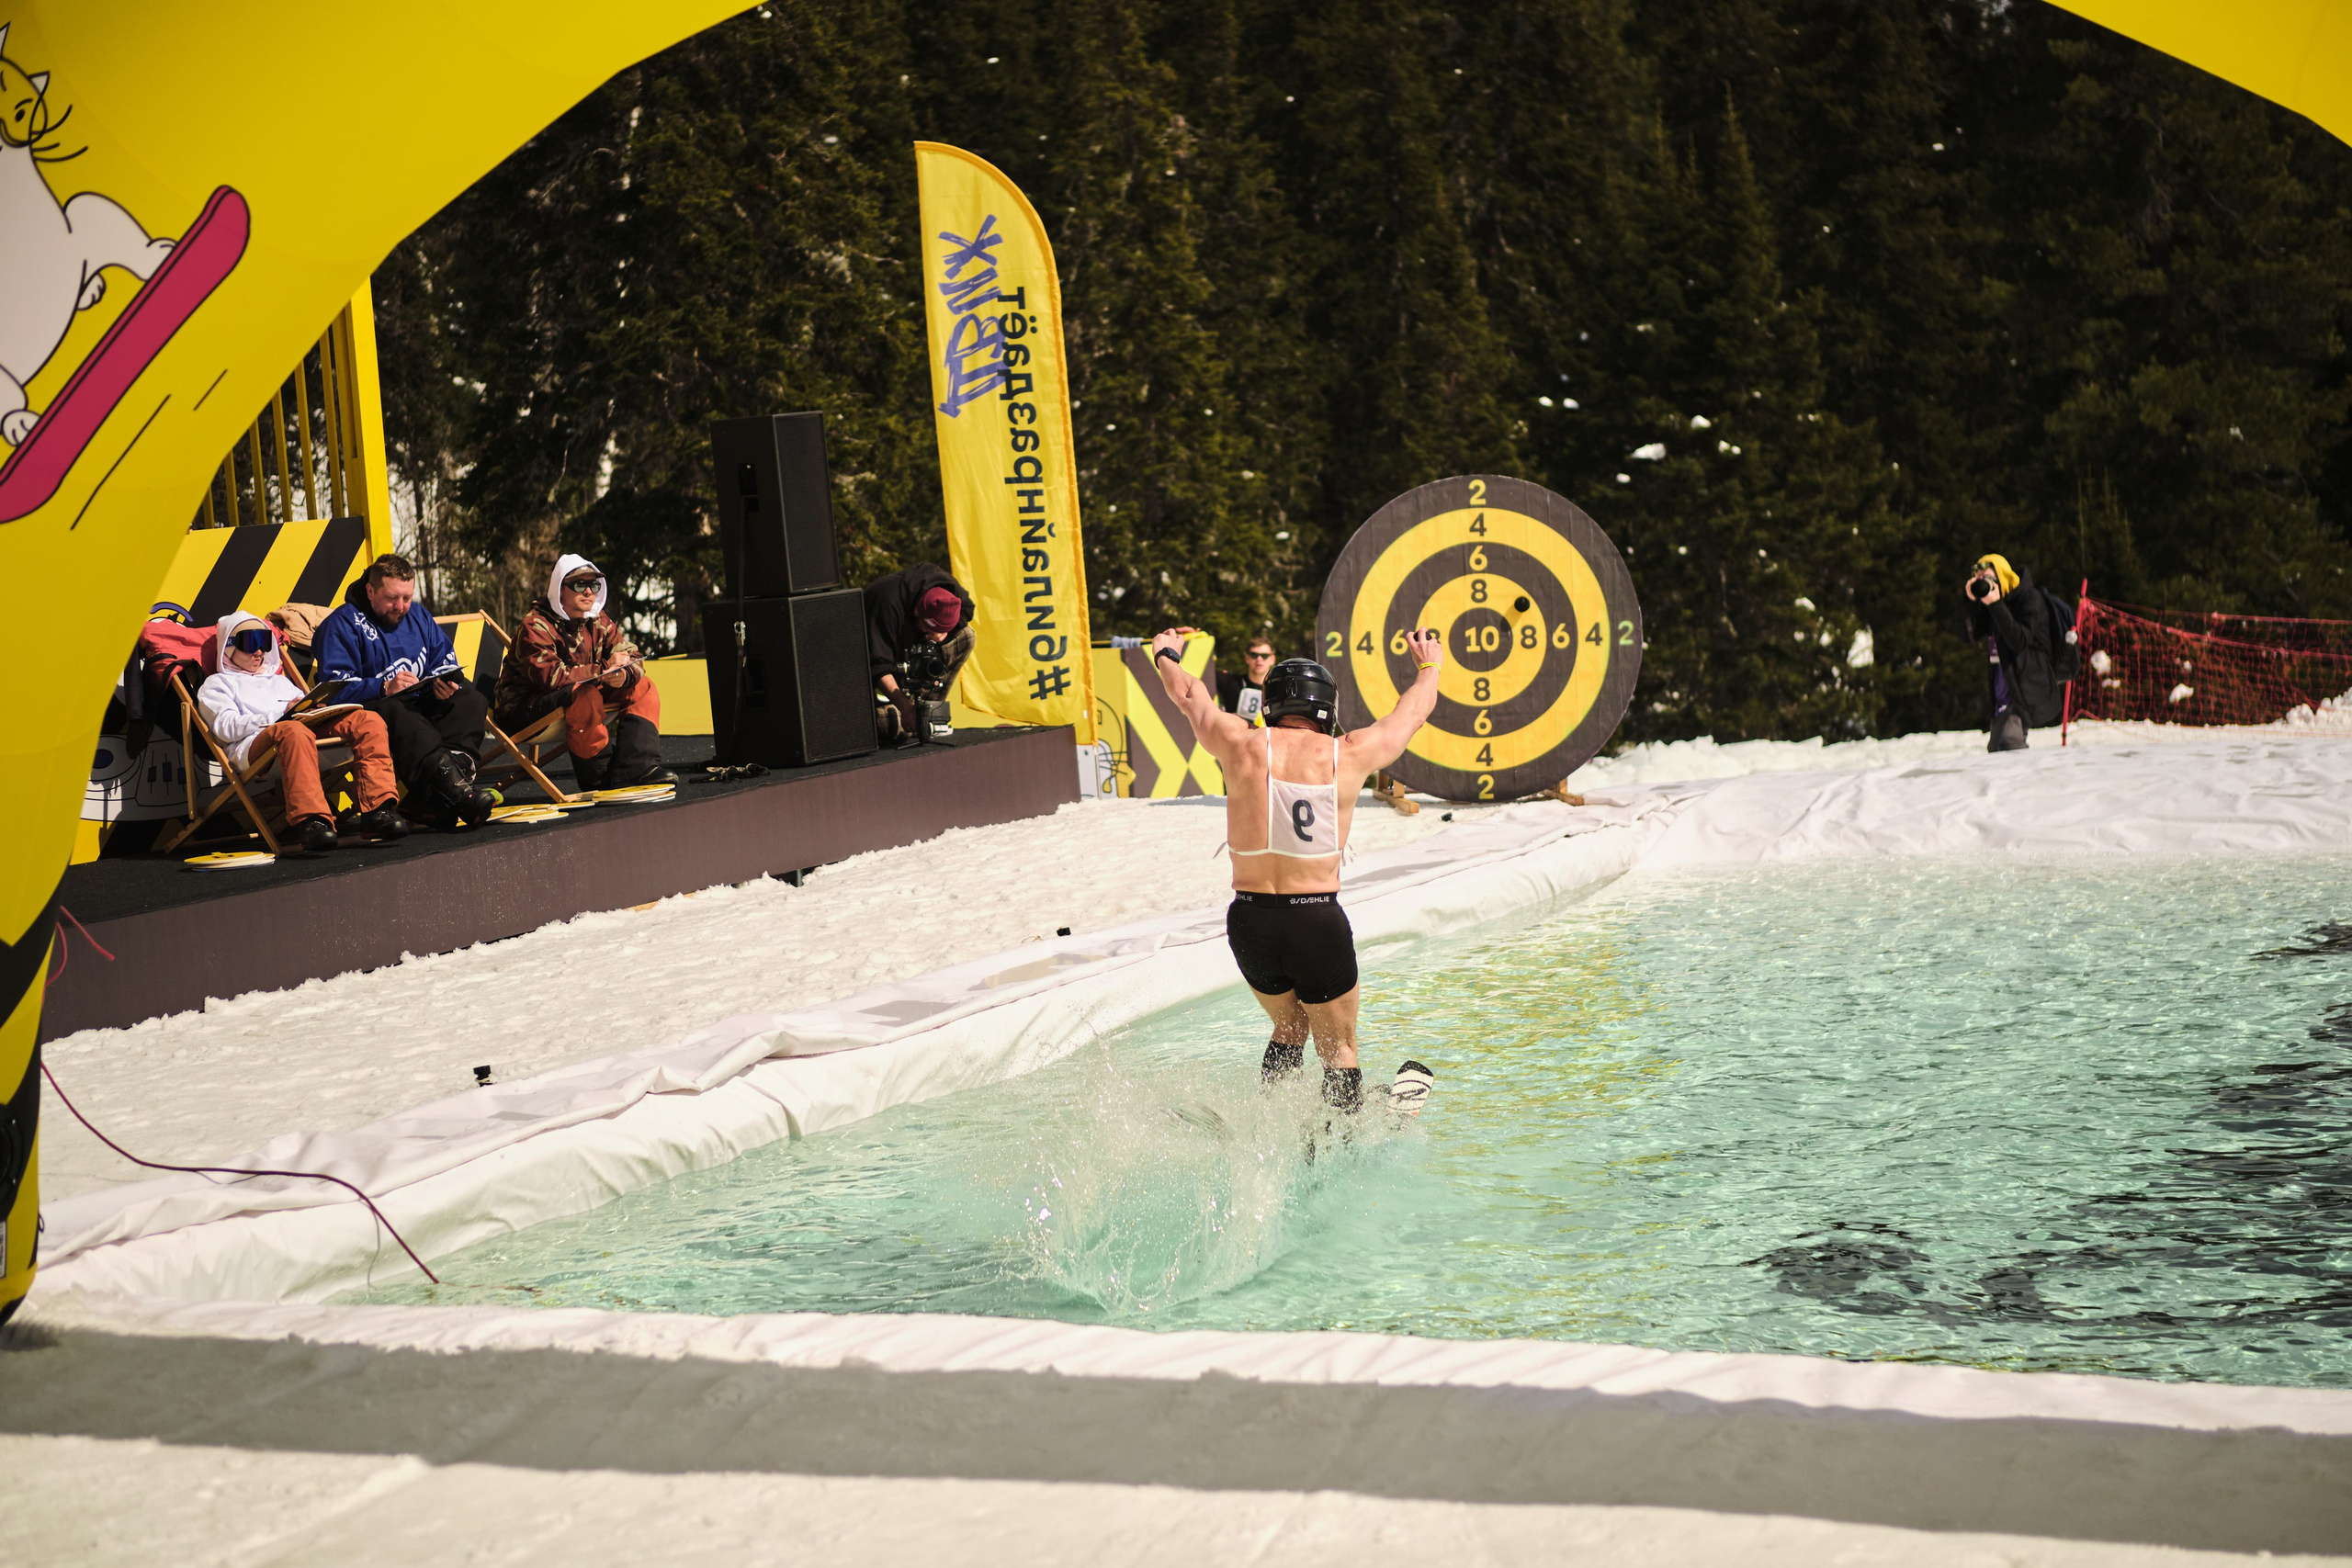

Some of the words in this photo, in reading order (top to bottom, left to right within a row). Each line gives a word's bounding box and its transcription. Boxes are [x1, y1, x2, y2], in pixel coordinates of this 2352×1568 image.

[1468, 479, 1487, 505] 2
[1469, 513, 1487, 536] 4
[1469, 545, 1487, 571] 6
[1470, 579, 1487, 604] 8
[1326, 631, 1344, 658] 2
[1356, 631, 1374, 655] 4
[1389, 628, 1408, 656] 6
[1464, 626, 1499, 653] 10
[1520, 625, 1538, 649] 8
[1552, 622, 1570, 649] 6
[1585, 622, 1603, 645] 4
[1618, 620, 1634, 645] 2
[1473, 677, 1491, 702] 8
[1248, 696, 1259, 714] 8
[1474, 709, 1492, 736] 6
[1476, 742, 1494, 767] 4
[1476, 774, 1495, 800] 2
